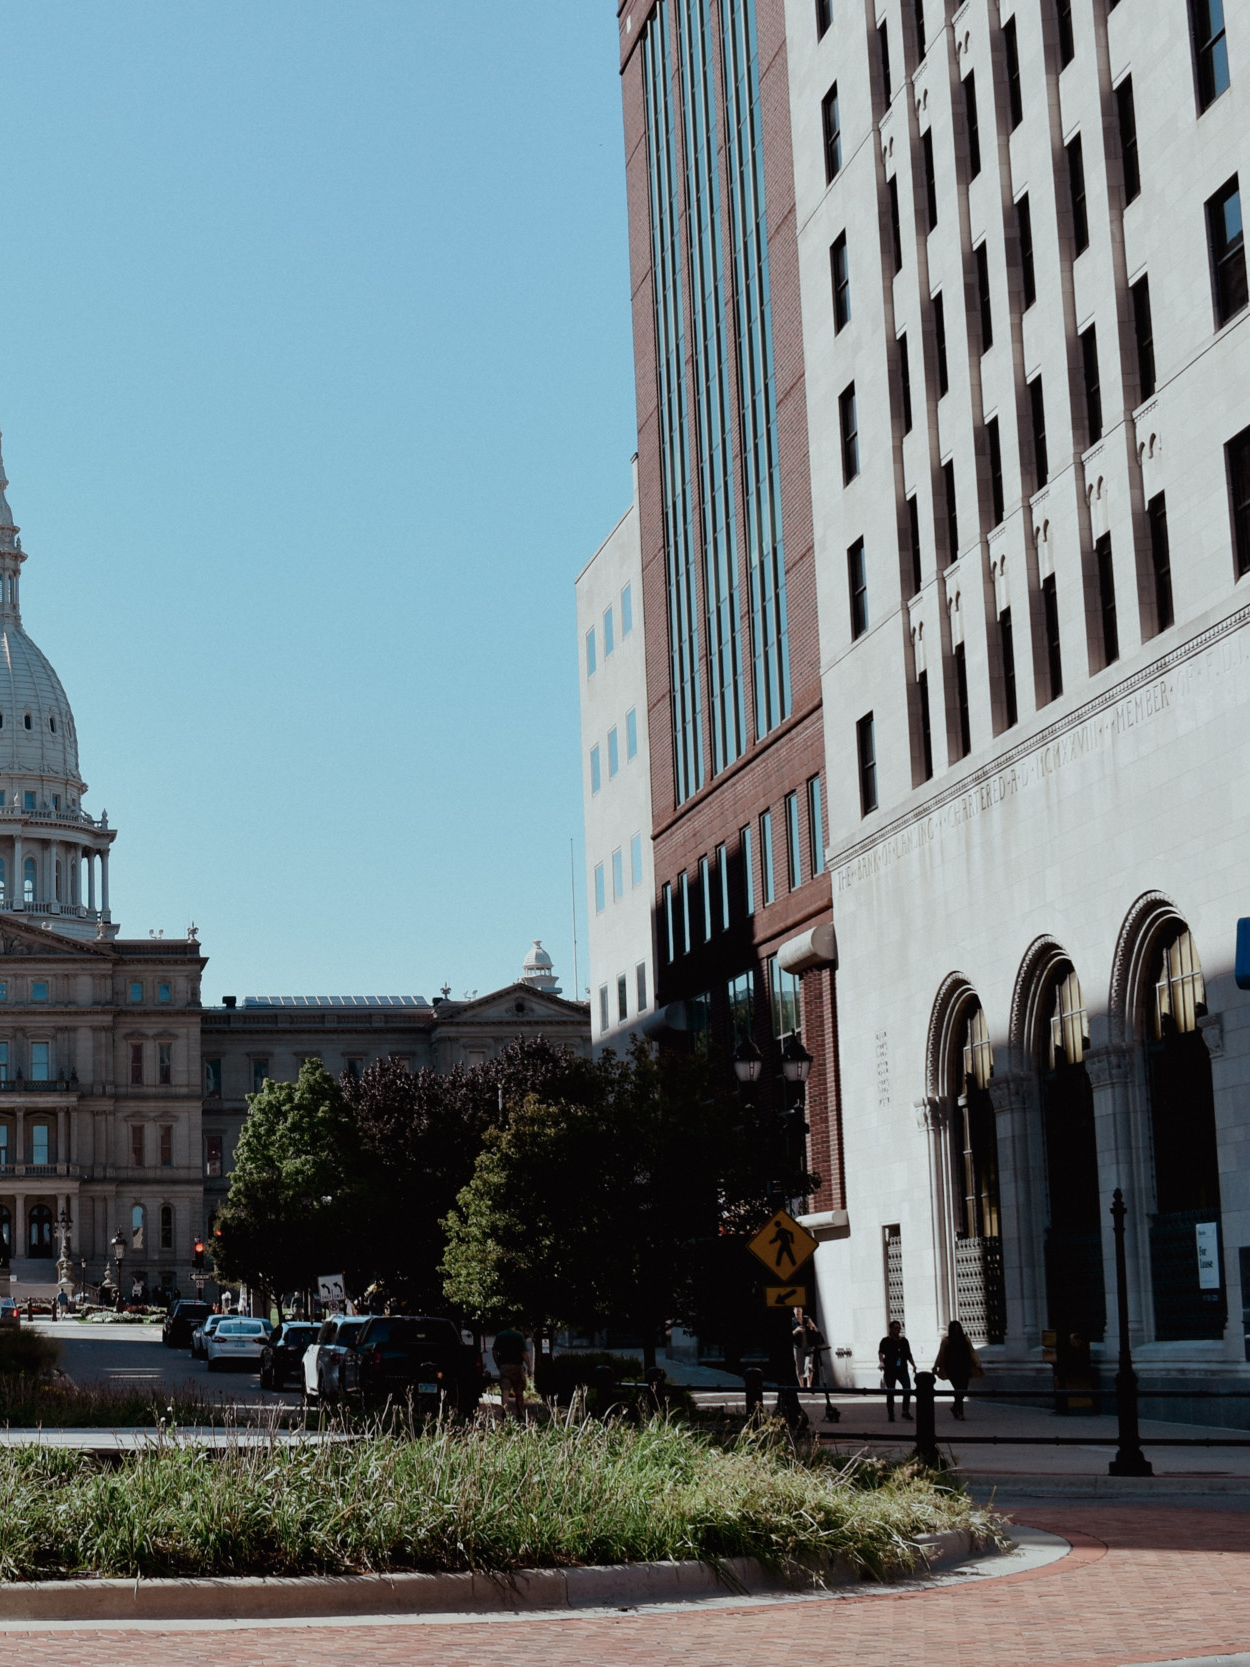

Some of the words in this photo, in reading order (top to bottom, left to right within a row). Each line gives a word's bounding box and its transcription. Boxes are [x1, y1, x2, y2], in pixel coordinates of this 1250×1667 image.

[837, 865, 851, 891] THE
[857, 850, 880, 880] BANK
[881, 842, 892, 867] OF
[894, 817, 934, 859] LANSING
[947, 776, 1006, 828] CHARTERED
[1115, 680, 1170, 734] MEMBER
